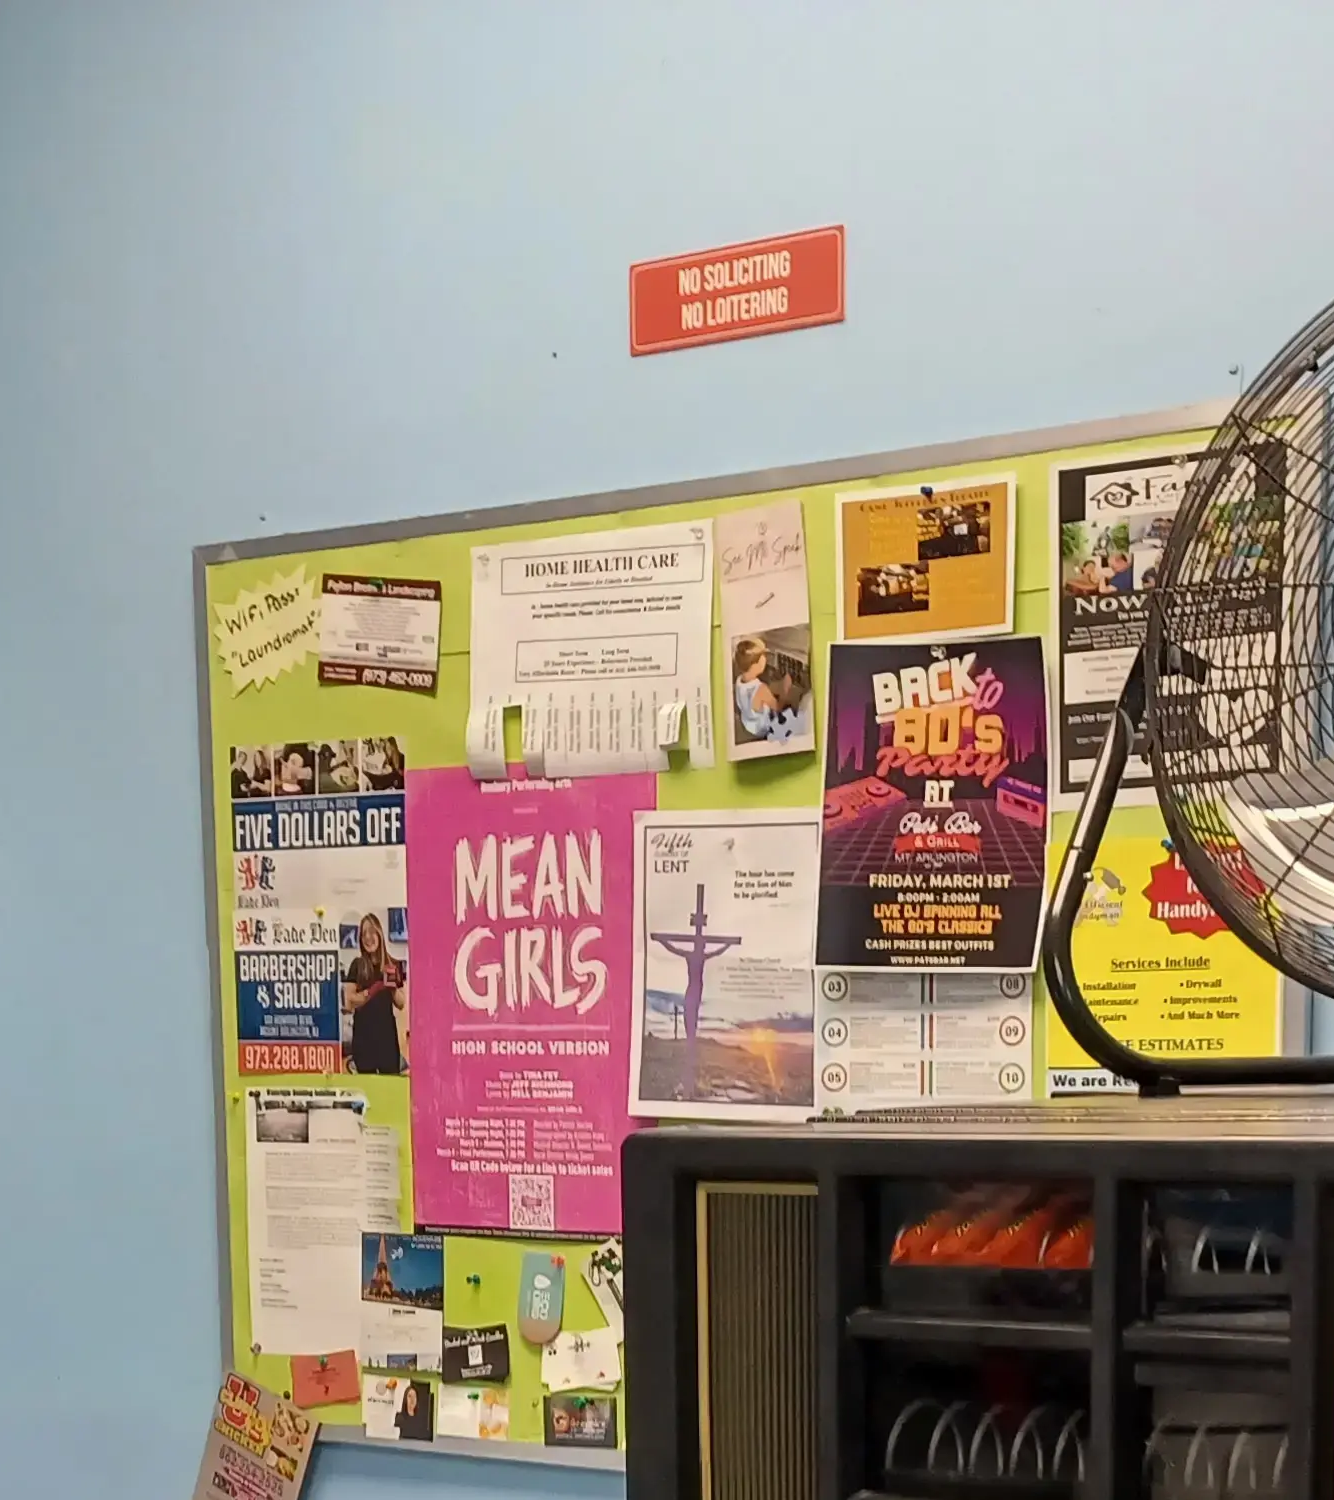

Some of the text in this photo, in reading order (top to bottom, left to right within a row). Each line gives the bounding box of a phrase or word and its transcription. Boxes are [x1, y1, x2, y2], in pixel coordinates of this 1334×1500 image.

[678, 250, 791, 296] NO SOLICITING
[681, 286, 788, 330] NO LOITERING
[525, 552, 679, 578] HOME HEALTH CARE
[872, 652, 977, 716] BACK
[923, 780, 955, 807] AT
[235, 807, 401, 850] FIVE DOLLARS OFF
[916, 851, 978, 864] ARLINGTON
[654, 860, 689, 874] LENT
[456, 828, 604, 925] MEAN
[869, 874, 927, 889] FRIDAY,
[930, 874, 983, 888] MARCH
[873, 904, 901, 919] LIVE
[881, 919, 904, 934] THE
[865, 939, 891, 950] CASH
[239, 954, 336, 982] BARBERSHOP
[455, 924, 608, 1017] GIRLS
[1111, 956, 1210, 970] Services Include
[1082, 979, 1223, 991] Installation Drywall
[257, 982, 321, 1009] & SALON
[1084, 995, 1238, 1006] aintenance Improvements
[1167, 1011, 1185, 1021] And
[1186, 1011, 1214, 1021] Much
[1216, 1011, 1240, 1020] More
[452, 1040, 610, 1056] HIGH SCHOOL VERSION
[1138, 1038, 1224, 1051] ESTIMATES
[1052, 1075, 1107, 1088] We are
[451, 1160, 468, 1172] Scan
[480, 1162, 499, 1173] Code
